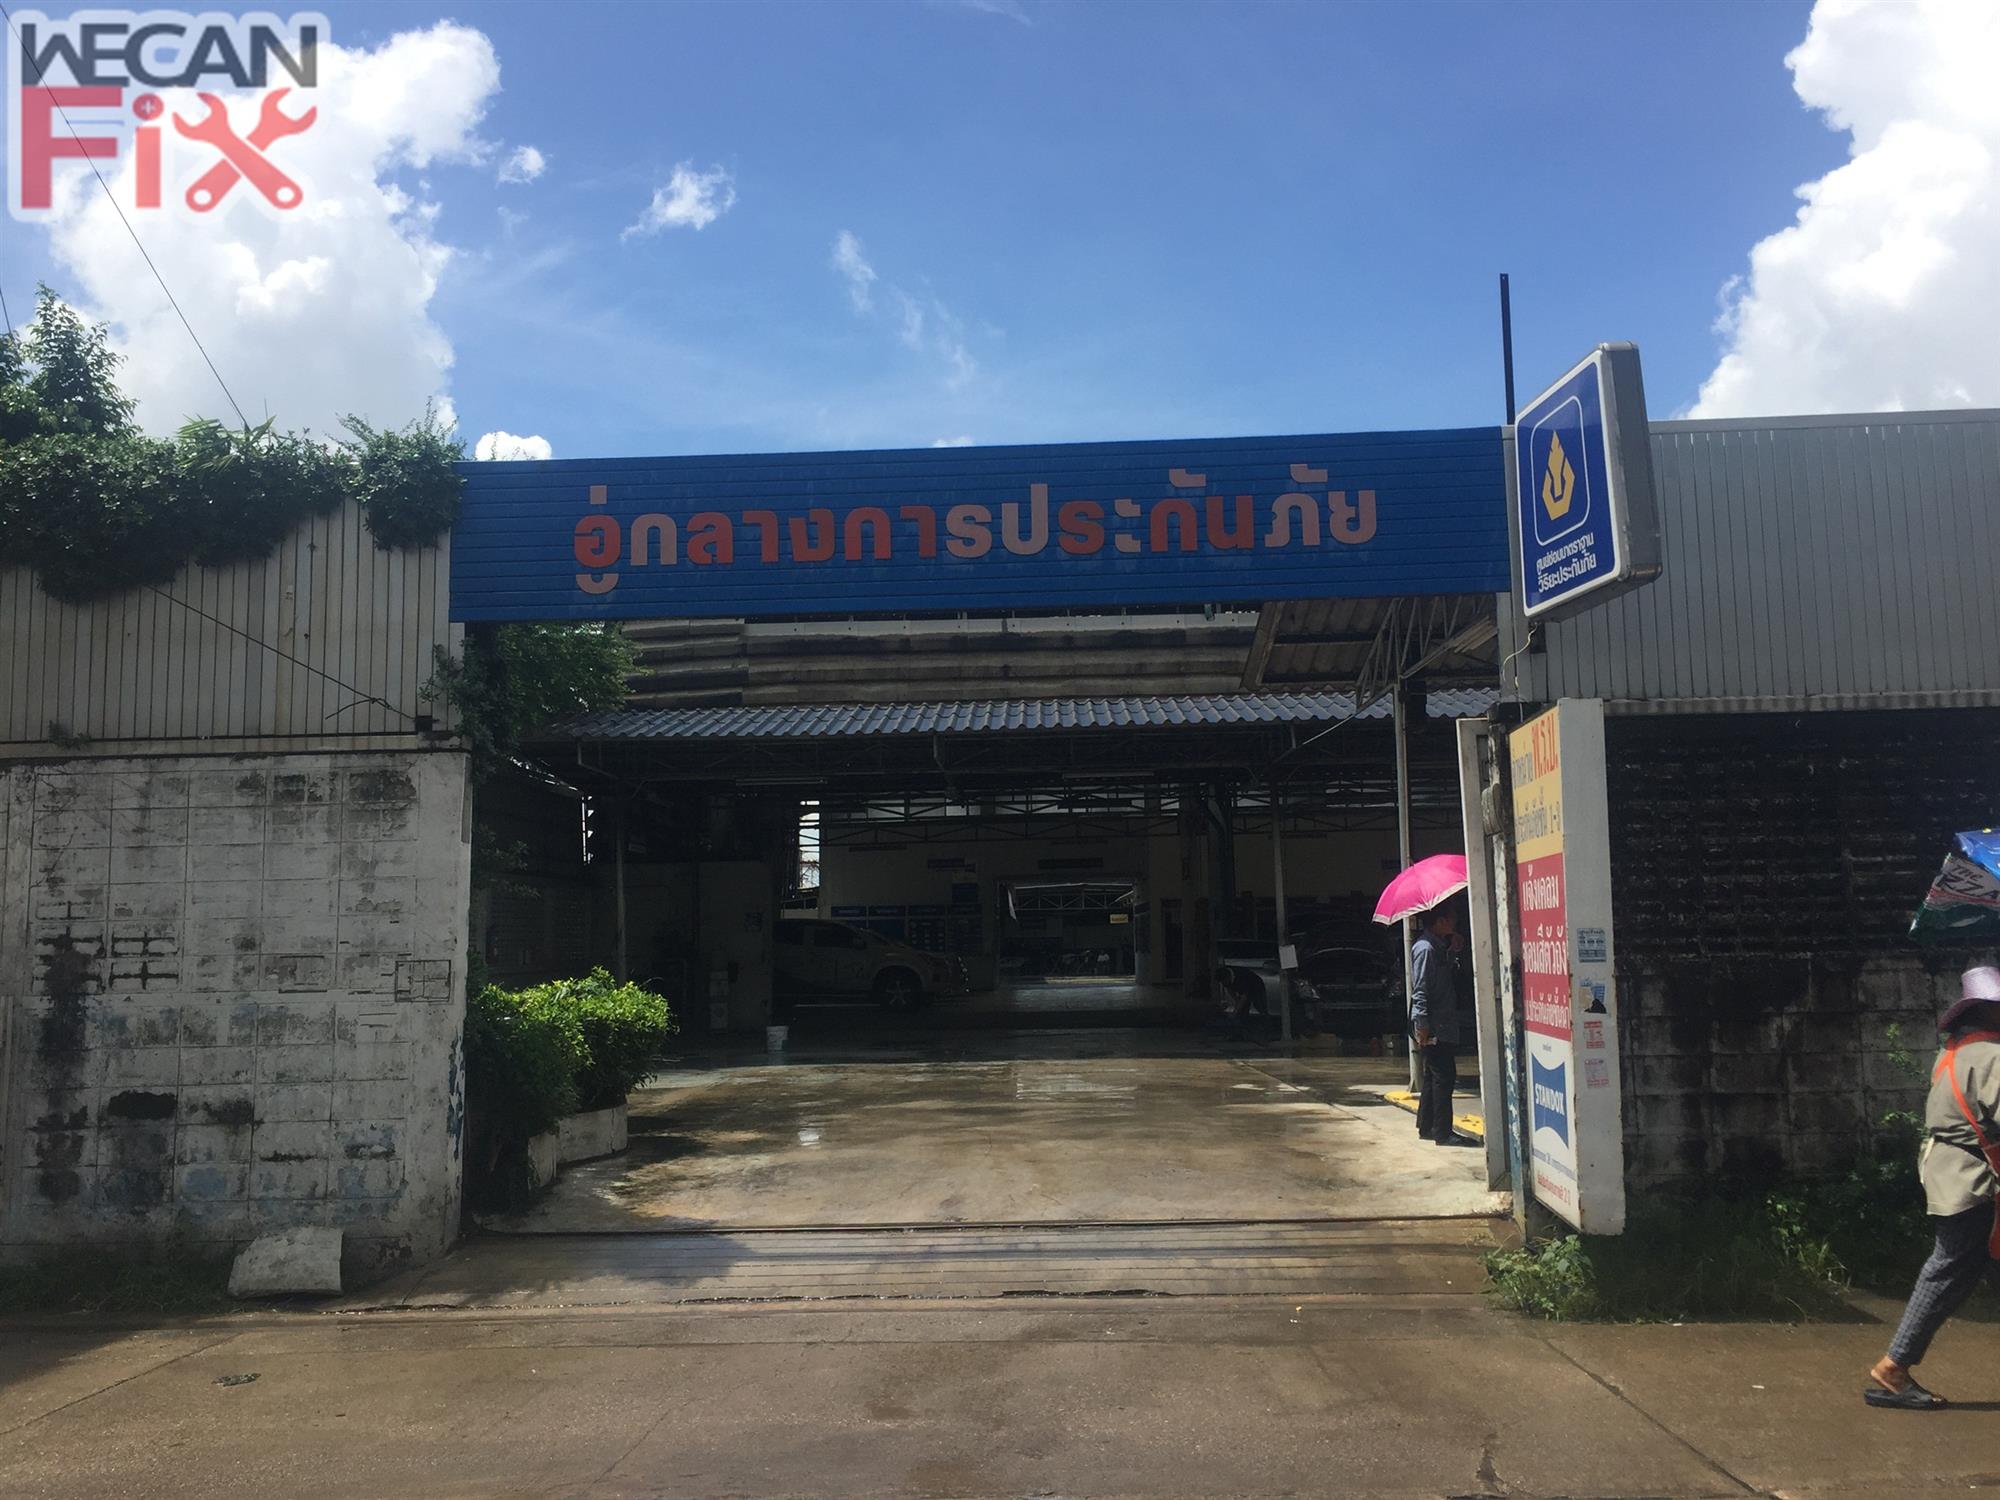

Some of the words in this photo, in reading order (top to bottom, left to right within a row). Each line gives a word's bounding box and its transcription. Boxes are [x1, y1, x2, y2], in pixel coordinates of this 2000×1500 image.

[574, 464, 1377, 594] อู่กลางการประกันภัย
[1538, 552, 1597, 592] วิริยะประกันภัย
[1535, 1083, 1565, 1116] STANDOX
